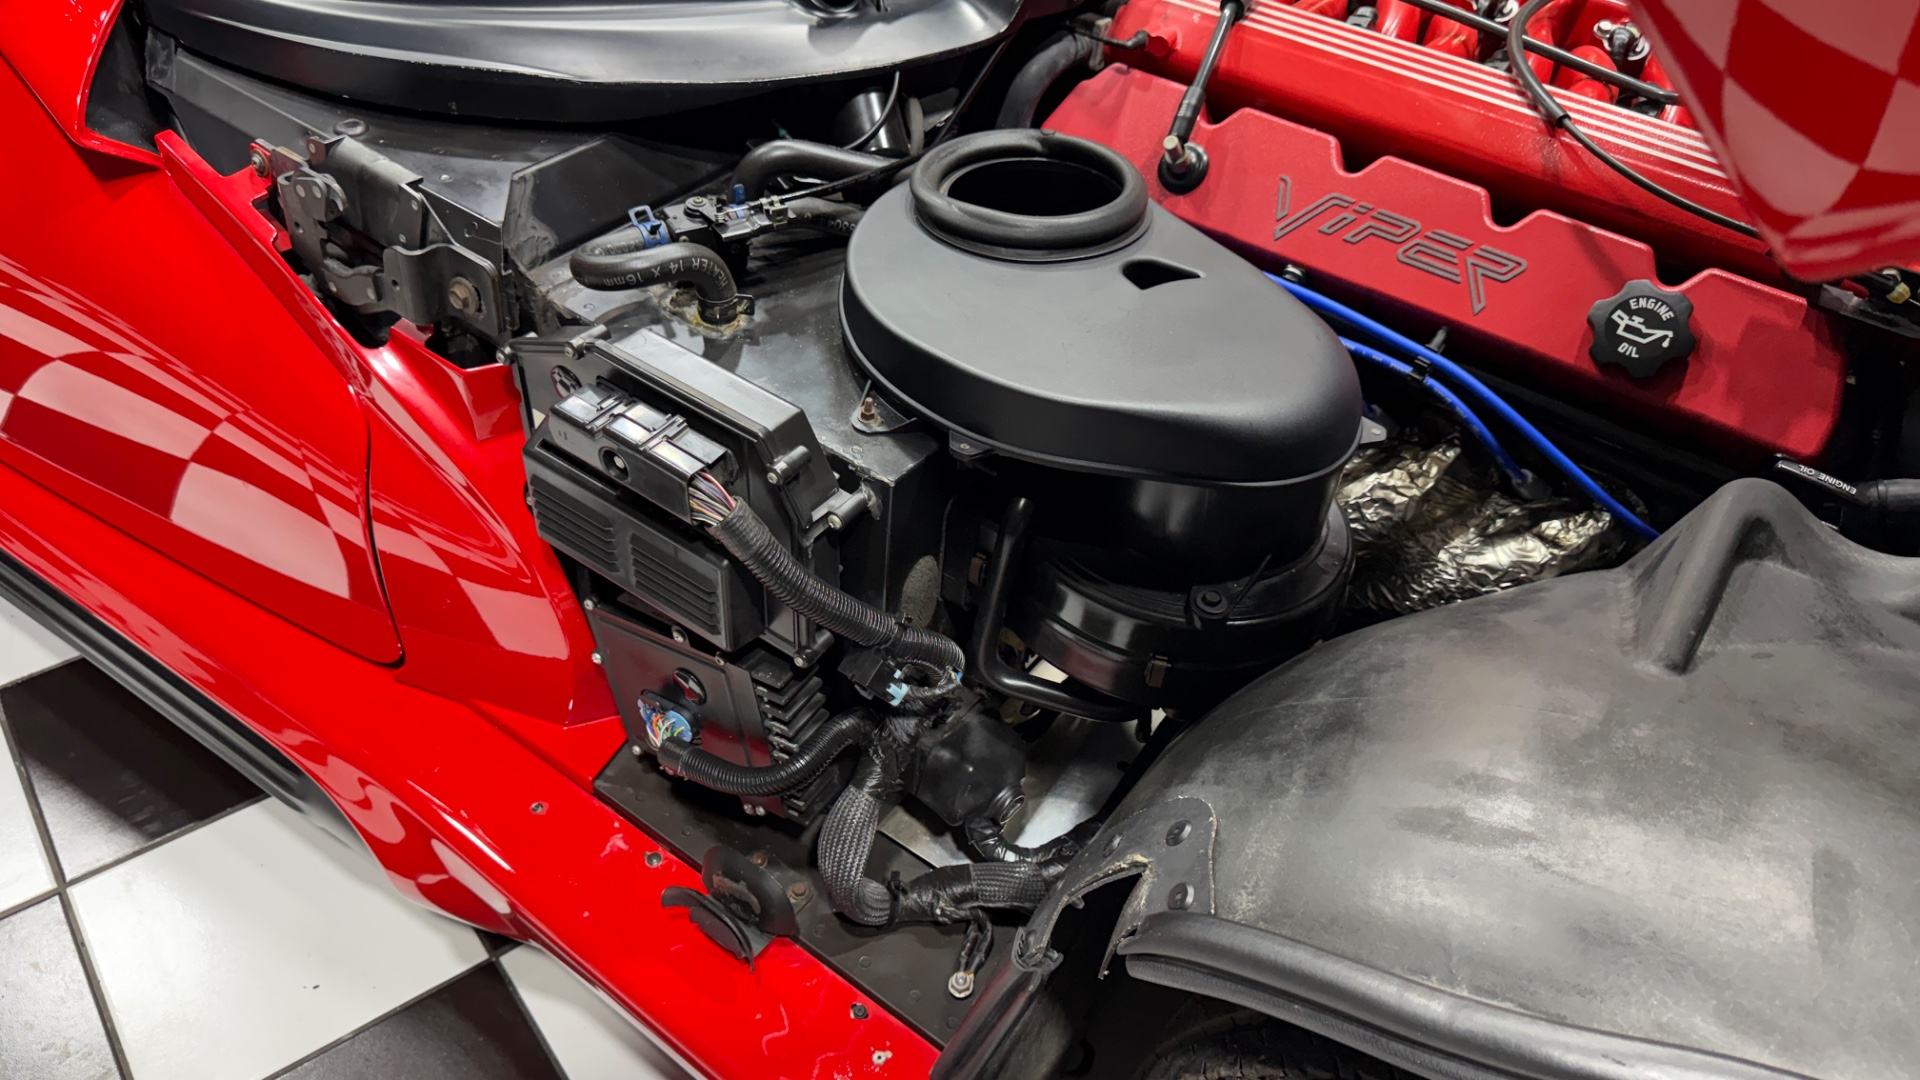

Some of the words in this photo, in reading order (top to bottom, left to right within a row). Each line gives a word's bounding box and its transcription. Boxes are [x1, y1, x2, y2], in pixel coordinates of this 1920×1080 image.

[669, 259, 685, 274] 14
[691, 257, 729, 290] HEATER
[603, 272, 644, 287] 16mm
[1629, 297, 1675, 321] ENGINE
[1617, 342, 1639, 358] OIL
[1798, 464, 1815, 475] OIL
[1817, 472, 1857, 495] ENGINE
